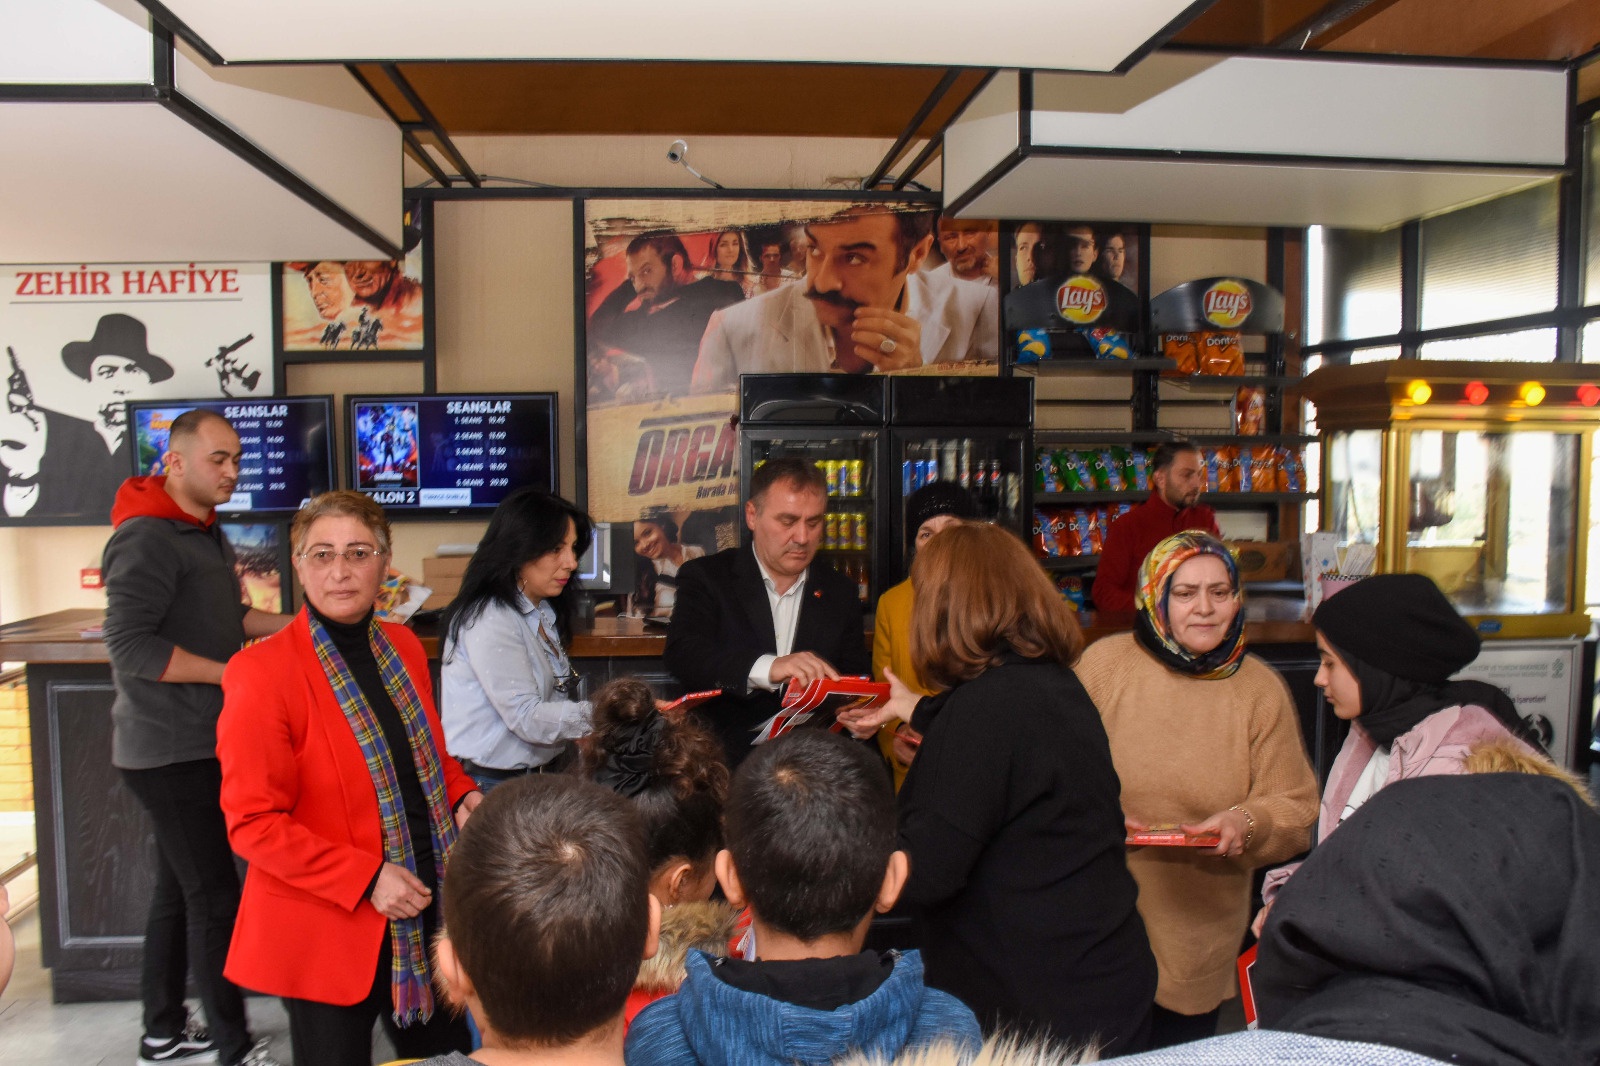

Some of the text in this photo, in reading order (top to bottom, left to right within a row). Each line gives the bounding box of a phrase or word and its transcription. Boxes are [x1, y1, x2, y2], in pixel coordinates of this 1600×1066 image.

[15, 263, 240, 296] ZEHİR HAFİYE
[224, 405, 288, 418] SEANSLAR
[446, 401, 512, 414] SEANSLAR
[628, 422, 737, 496] ORGA
[406, 491, 416, 503] 2
